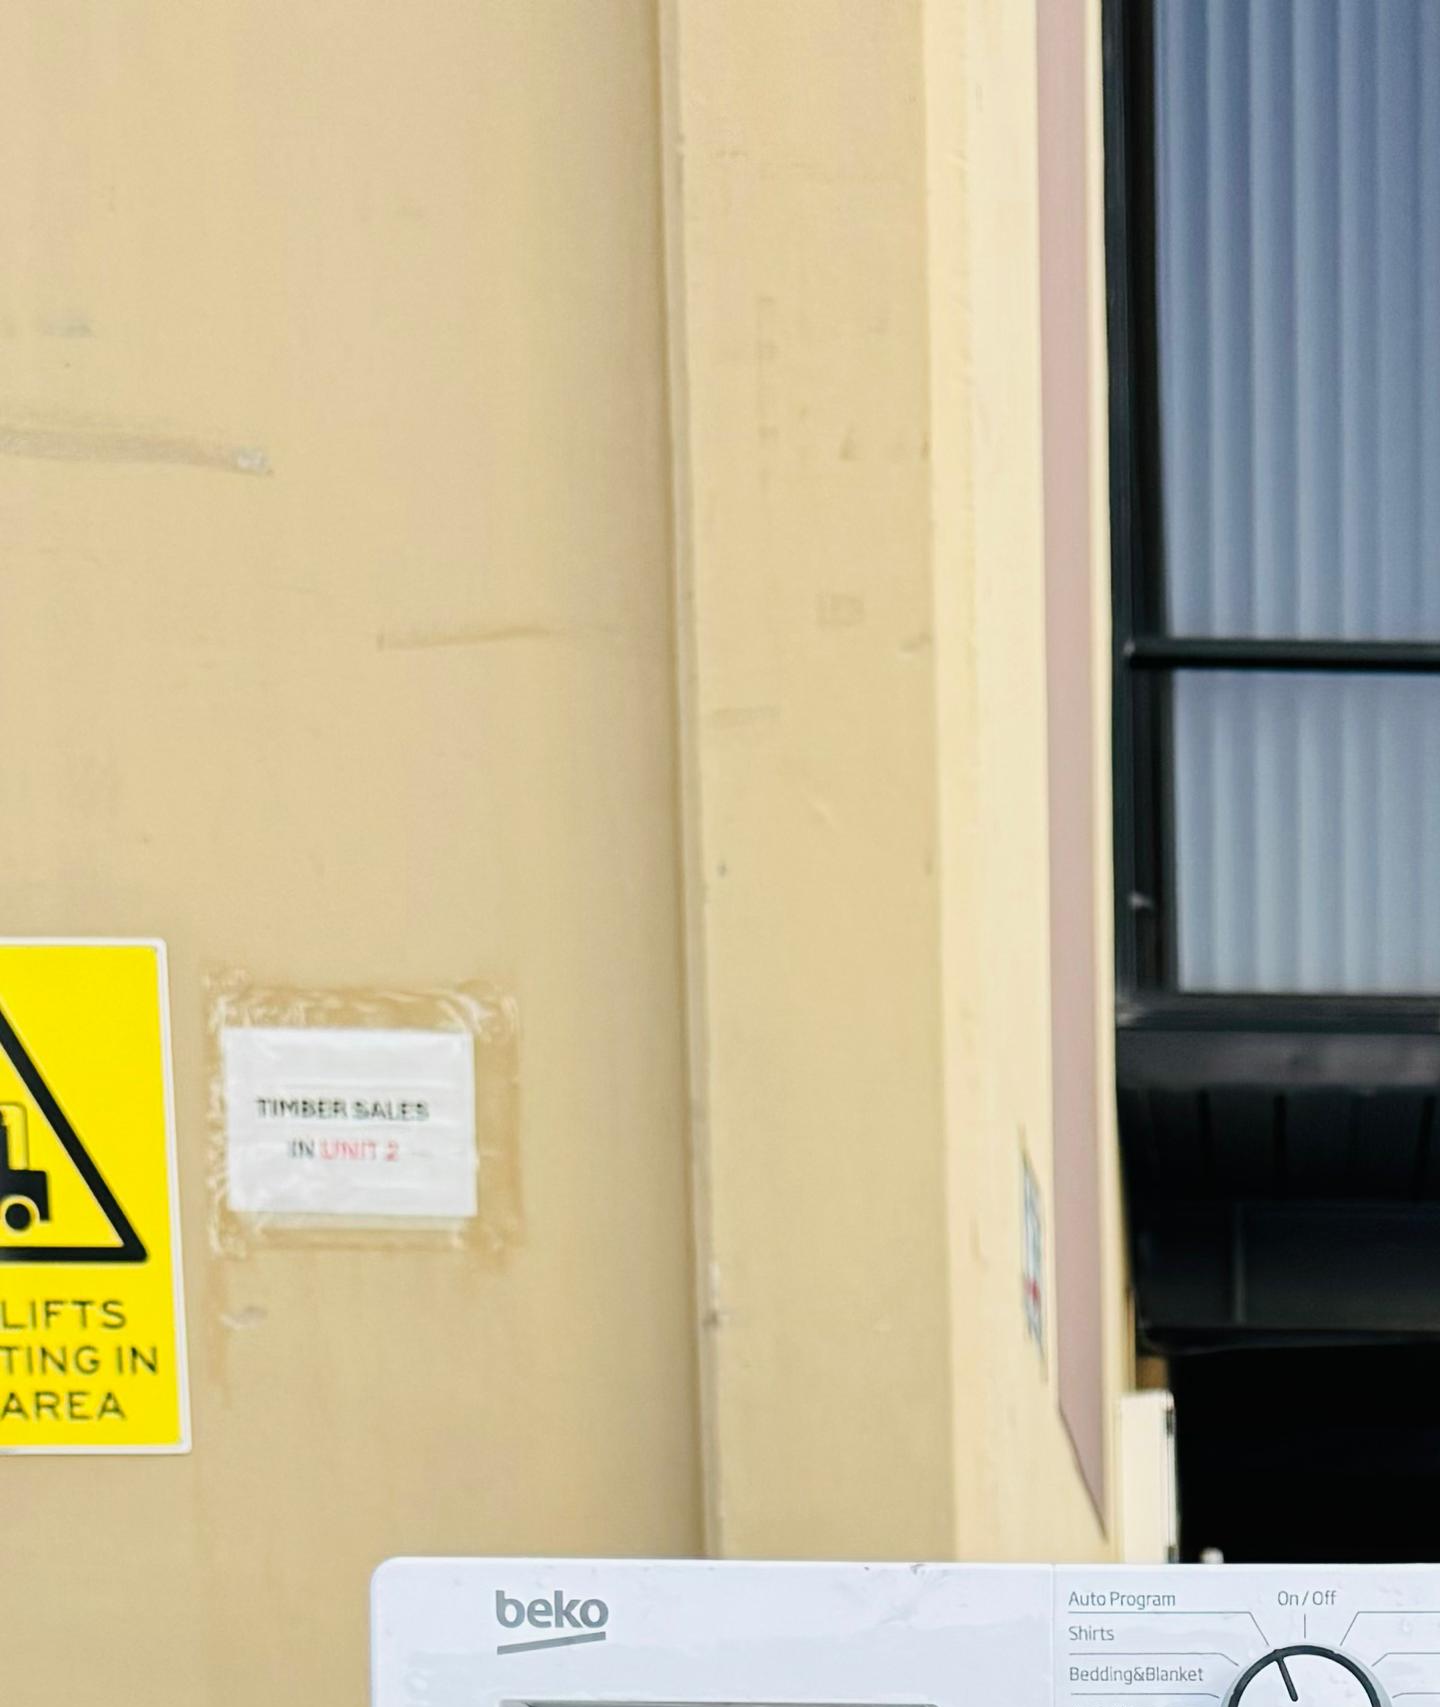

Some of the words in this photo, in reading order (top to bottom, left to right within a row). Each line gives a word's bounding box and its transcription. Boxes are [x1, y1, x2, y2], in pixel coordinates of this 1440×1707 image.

[256, 1097, 348, 1119] TIMBER
[352, 1099, 430, 1121] SALES
[289, 1138, 315, 1159] IN
[319, 1137, 376, 1160] UNIT
[384, 1140, 399, 1162] 2
[0, 1299, 127, 1330] LIFTS
[0, 1345, 100, 1375] TING
[116, 1345, 158, 1375] IN
[0, 1391, 127, 1420] AREA
[495, 1589, 609, 1629] beko
[1068, 1591, 1107, 1607] Auto
[1110, 1591, 1176, 1610] Program
[1277, 1591, 1299, 1606] On
[1312, 1591, 1338, 1606] Off
[1068, 1625, 1115, 1641] Shirts
[1069, 1666, 1204, 1685] Bedding&Blanket
